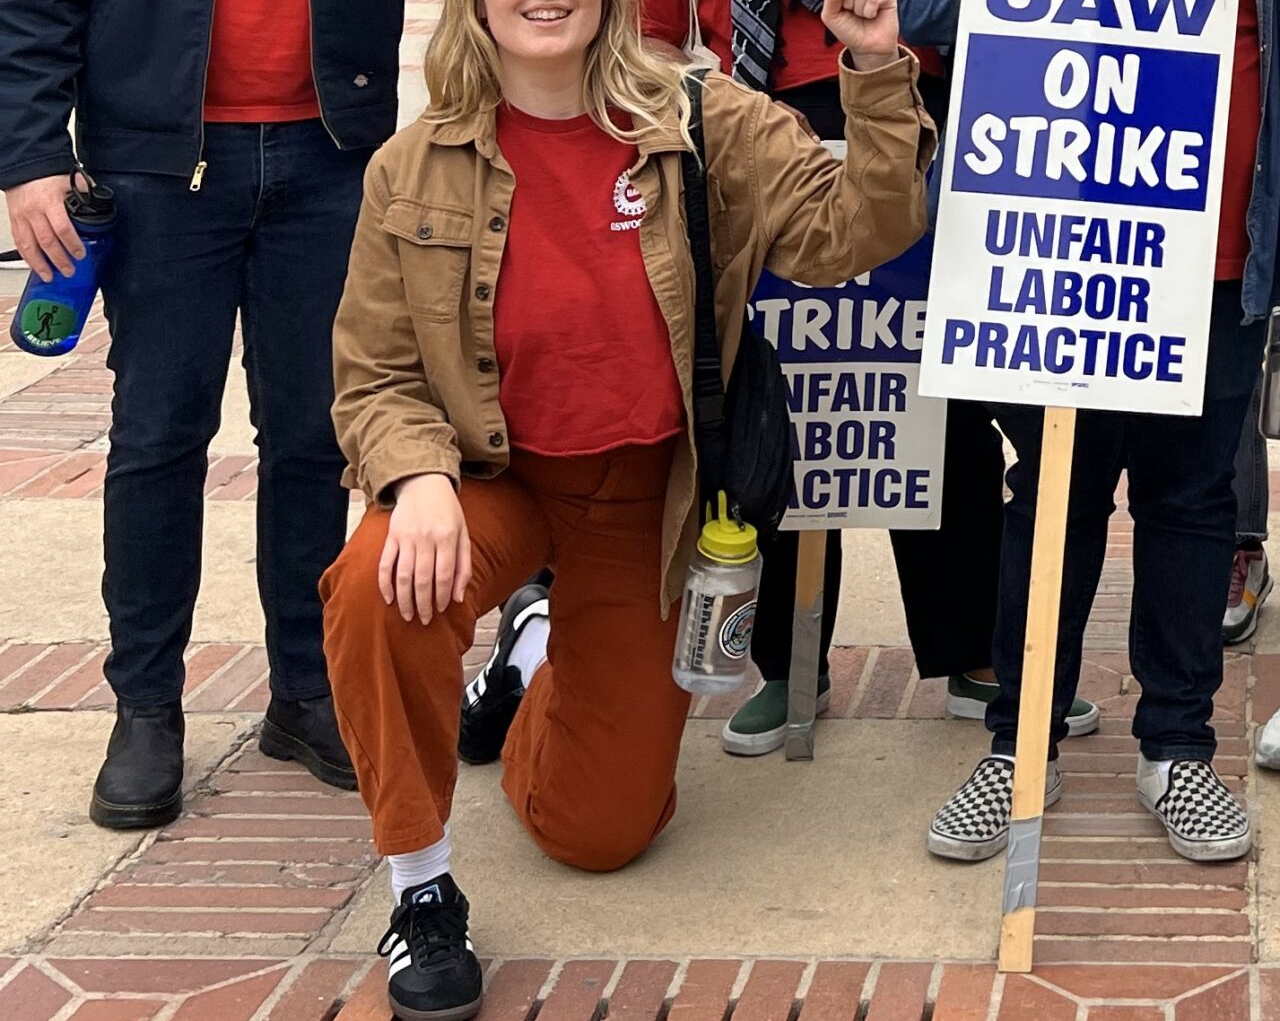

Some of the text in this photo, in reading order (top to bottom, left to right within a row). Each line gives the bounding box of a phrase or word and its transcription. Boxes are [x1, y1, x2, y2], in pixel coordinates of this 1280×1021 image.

[1044, 49, 1140, 115] ON
[964, 113, 1204, 191] STRIKE
[984, 210, 1166, 268] UNFAIR
[747, 296, 928, 350] TRIKE
[987, 266, 1150, 324] LABOR
[940, 318, 1186, 383] PRACTICE
[782, 372, 907, 413] NFAIR
[789, 420, 896, 461] BOR
[788, 468, 930, 509] CTICE
